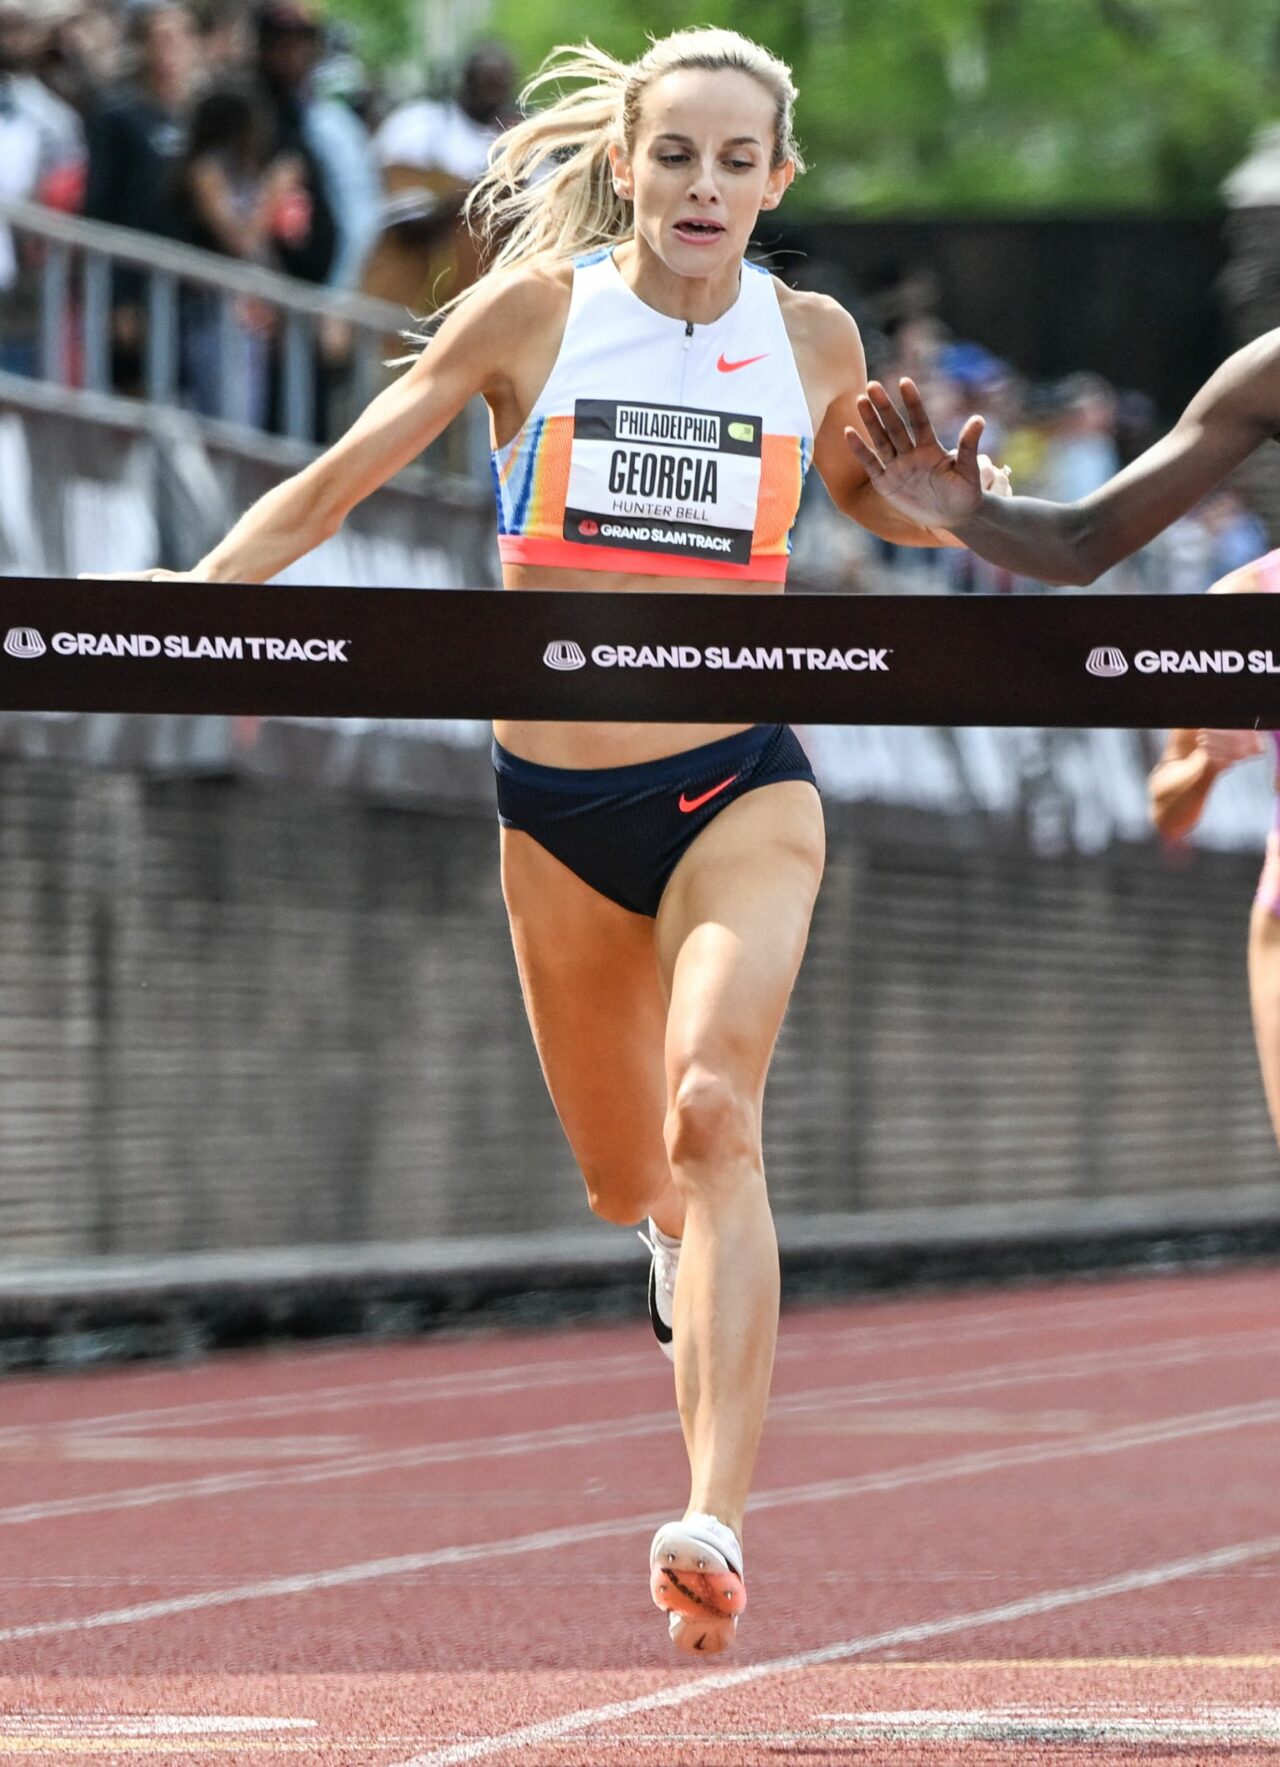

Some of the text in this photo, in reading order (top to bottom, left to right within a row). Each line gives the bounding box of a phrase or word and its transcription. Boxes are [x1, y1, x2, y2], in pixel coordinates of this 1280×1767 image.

[618, 409, 718, 444] PHILADELPHIA
[608, 449, 717, 503] GEORGIA
[612, 500, 710, 522] HUNTER BELL
[600, 523, 732, 552] GRAND SLAM TRACK
[52, 633, 348, 662] GRAND SLAM TRACK
[592, 644, 889, 671] GRAND SLAM TRACK
[1133, 650, 1245, 674] GRAND
